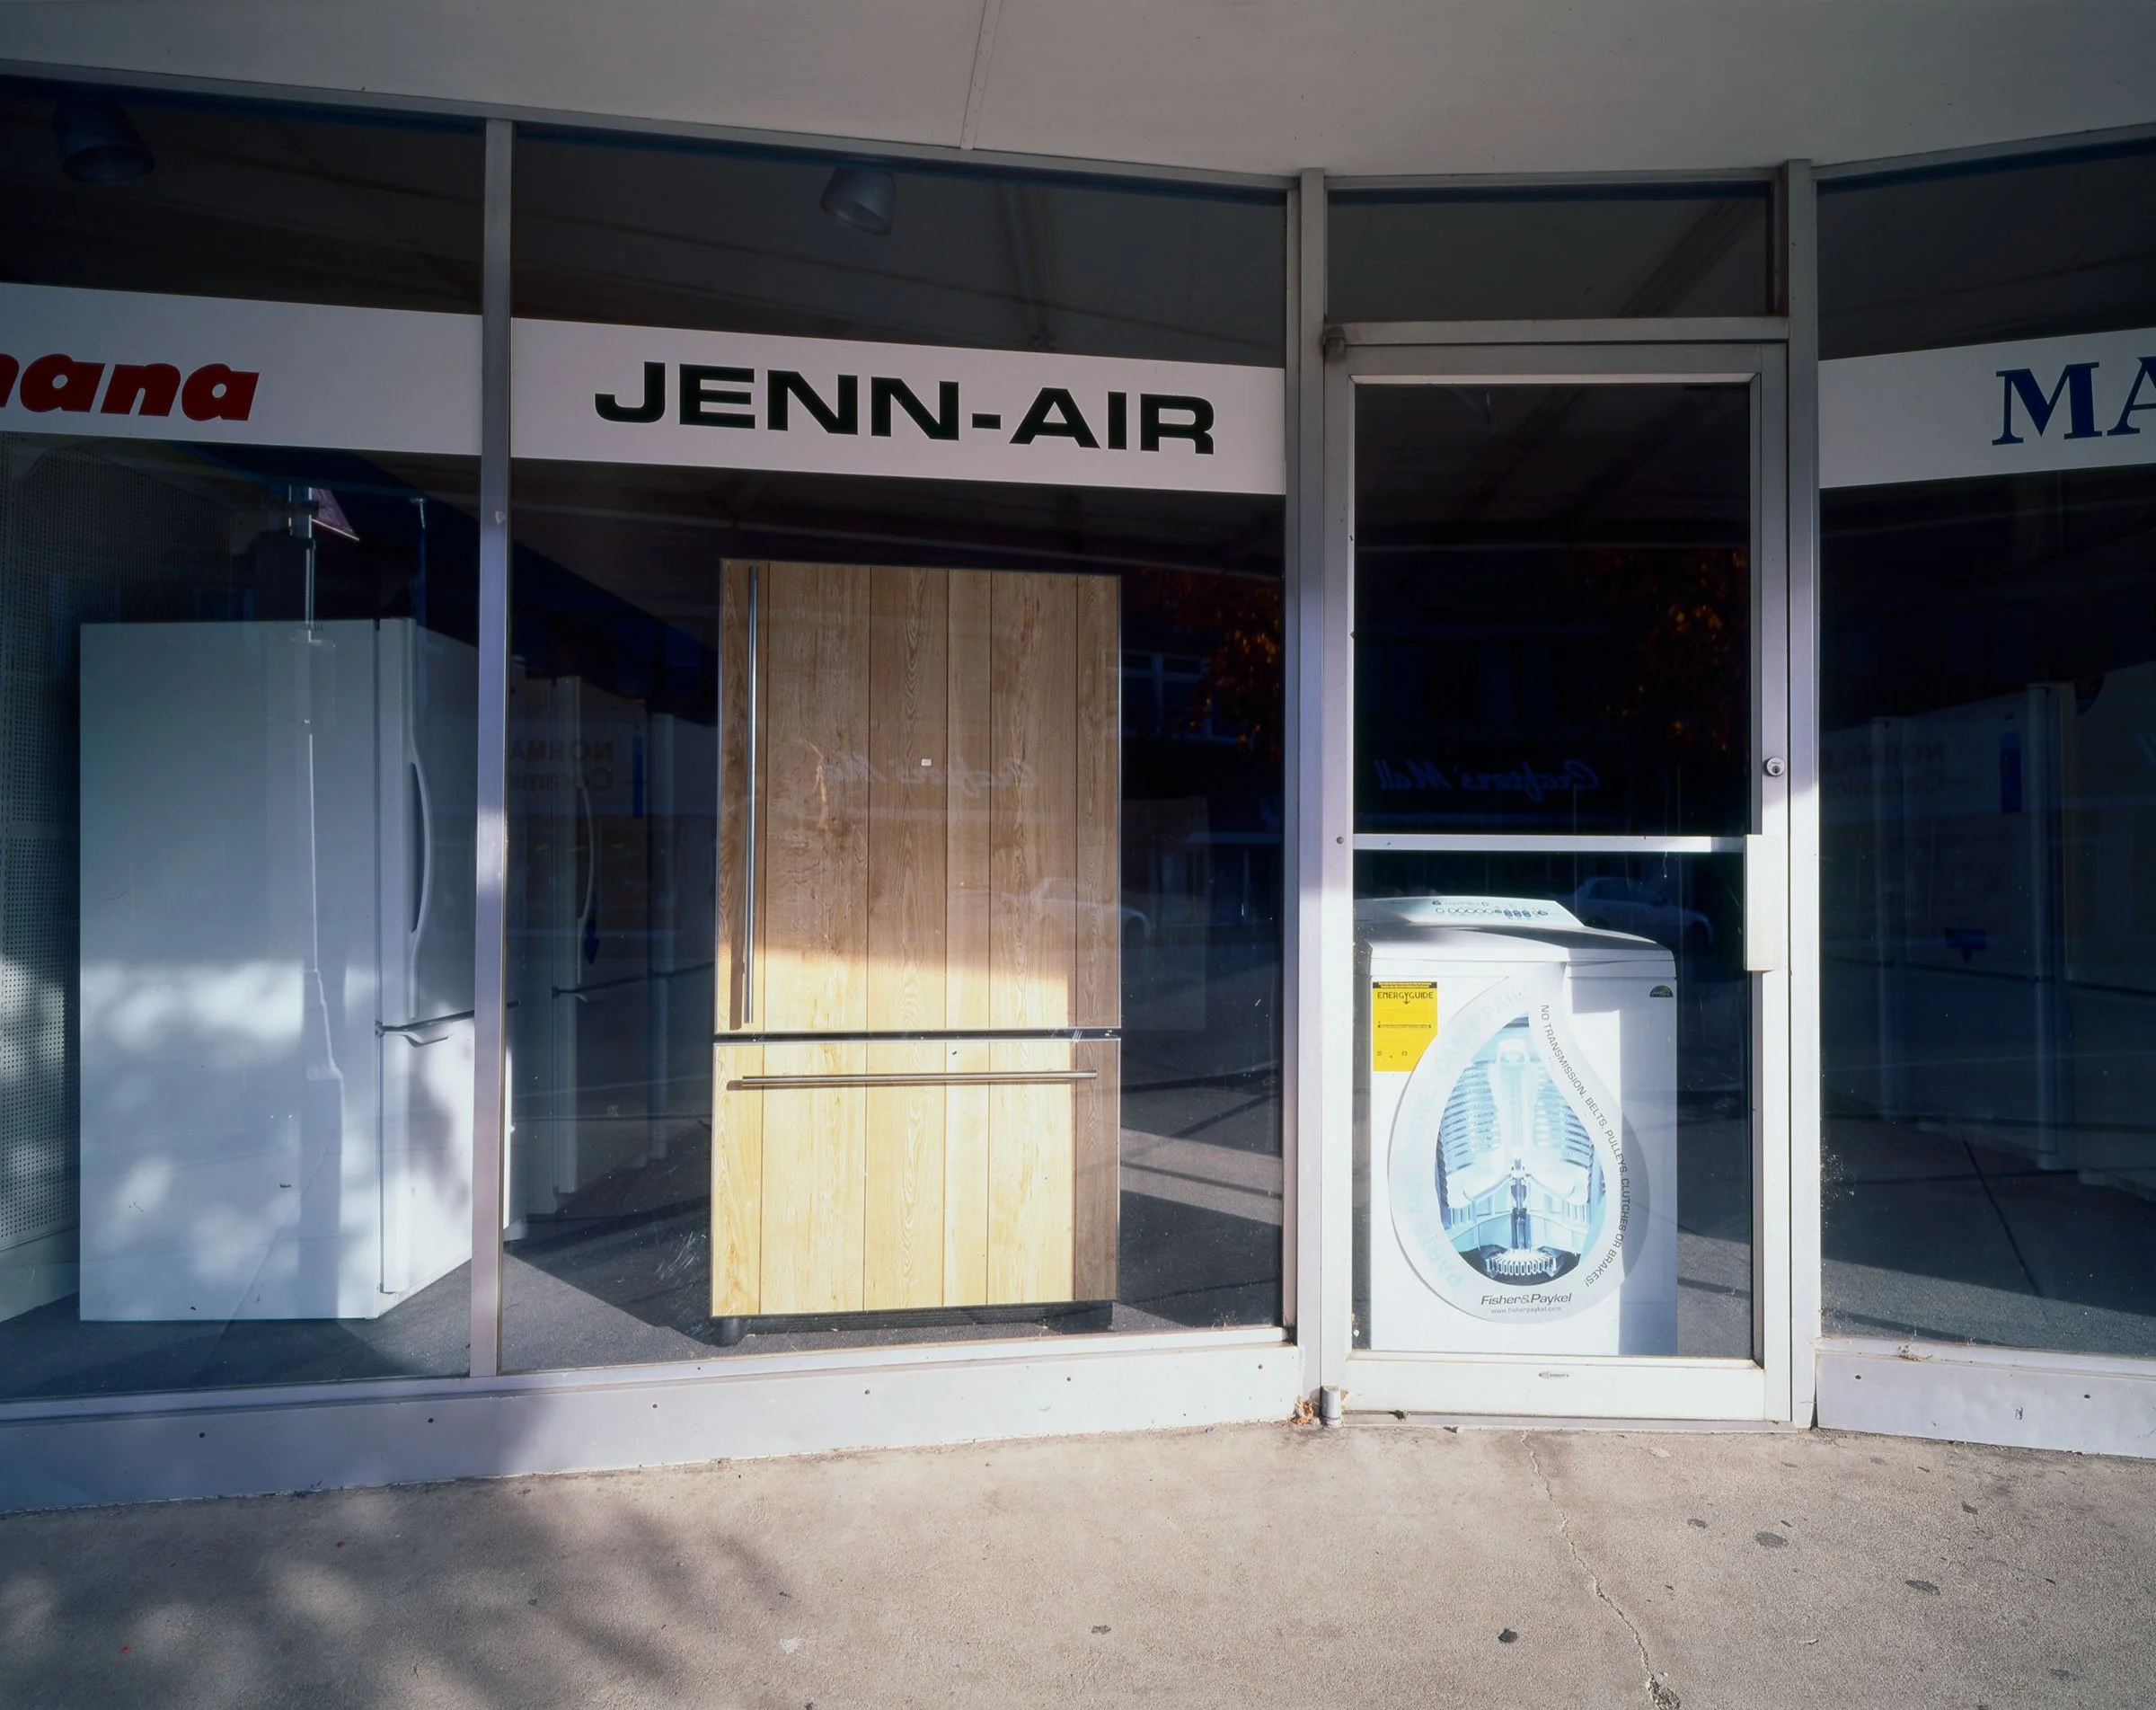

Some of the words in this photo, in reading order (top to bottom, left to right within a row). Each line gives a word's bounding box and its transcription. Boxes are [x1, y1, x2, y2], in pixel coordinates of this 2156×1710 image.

[595, 361, 1214, 455] JENN-AIR
[1992, 356, 2156, 446] MA
[1377, 991, 1434, 1000] ENERGYGUIDE
[1542, 1005, 1550, 1021] NO
[1543, 1022, 1586, 1098] TRANSMISSION,
[1618, 1178, 1630, 1232] CLUTCHES
[1414, 1220, 1465, 1288] PARTS
[1613, 1233, 1624, 1248] OR
[1585, 1249, 1617, 1287] BRAKES!
[1481, 1292, 1572, 1306] Fisher&Paykel
[1491, 1306, 1562, 1314] www.fisherpaykel.com
